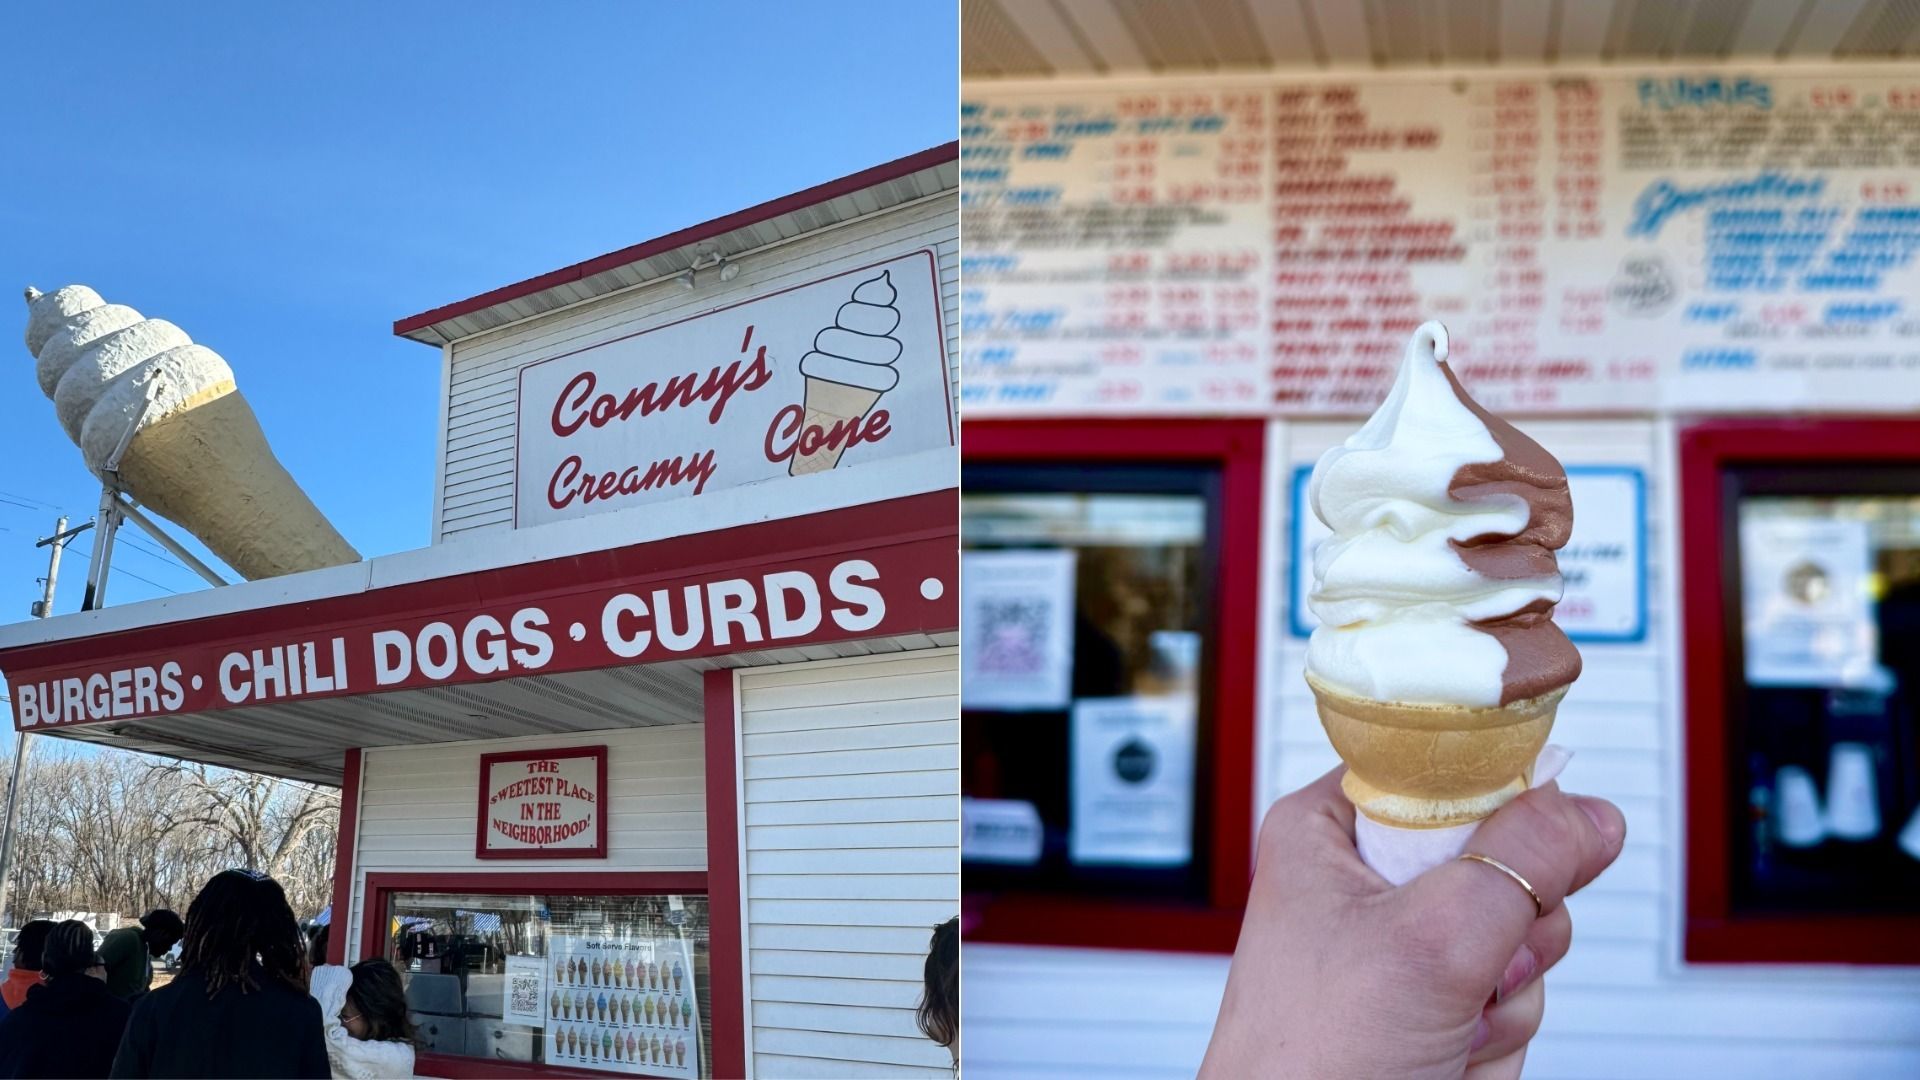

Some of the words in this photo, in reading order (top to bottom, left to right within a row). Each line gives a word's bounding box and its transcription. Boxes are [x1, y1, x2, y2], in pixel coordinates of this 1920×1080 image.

[551, 325, 773, 438] Conny's
[547, 449, 717, 510] Creamy
[764, 404, 892, 463] Cone
[18, 661, 184, 727] BURGERS
[218, 637, 348, 704] CHILI
[373, 607, 554, 686] DOGS
[601, 559, 886, 658] CURDS
[527, 761, 560, 774] THE
[490, 777, 554, 804] SWEETEST
[556, 778, 595, 803] PLACE
[520, 803, 534, 820] IN
[537, 802, 562, 820] THE
[493, 813, 591, 844] NEIGHBORHOOD!
[586, 942, 601, 950] Soft
